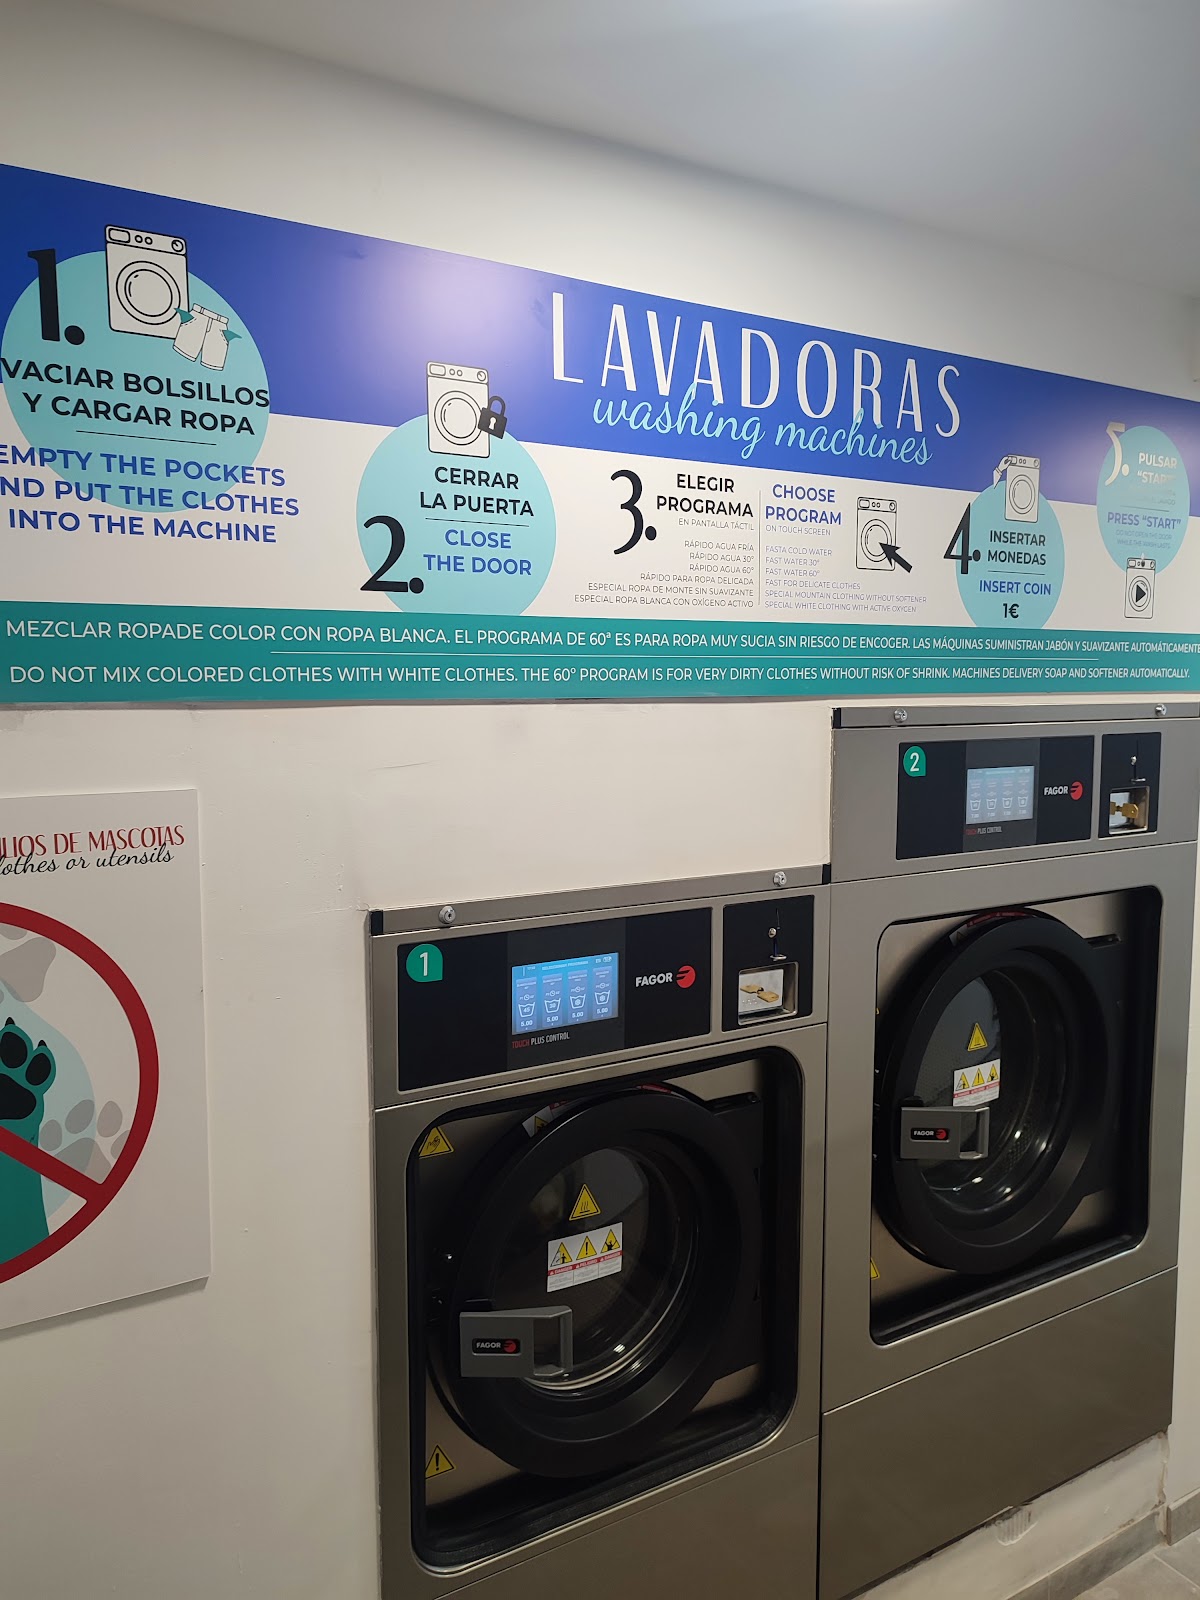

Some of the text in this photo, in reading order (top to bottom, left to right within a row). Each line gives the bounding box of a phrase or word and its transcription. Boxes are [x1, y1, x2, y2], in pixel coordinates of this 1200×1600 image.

[28, 248, 85, 345] 1.
[552, 292, 961, 439] LAVADORAS
[0, 357, 270, 408] VACIAR BOLSILLOS
[22, 392, 255, 435] Y CARGAR ROPA
[592, 381, 933, 466] washing machines
[0, 444, 286, 487] EMPTY THE POCKETS
[1138, 452, 1178, 469] PULSAR
[434, 466, 519, 490] CERRAR
[677, 473, 735, 493] ELEGIR
[55, 480, 300, 517] PUT THE CLOTHES
[772, 484, 836, 503] CHOOSE
[420, 491, 535, 517] LA PUERTA
[610, 469, 657, 555] 3.
[656, 495, 754, 518] PROGRAMA
[765, 505, 842, 525] PROGRAM
[1107, 512, 1140, 526] PRESS
[9, 508, 277, 543] INTO THE MACHINE
[678, 518, 755, 531] EN PANTALLA TÁCTIL
[766, 524, 831, 536] ON TOUCH SCREEN
[445, 529, 512, 549] CLOSE
[684, 540, 755, 552] RÁPIDO AGUA FRÍA
[943, 502, 981, 575] 4.
[989, 530, 1046, 547] INSERTAR
[360, 515, 425, 595] 2.
[689, 552, 741, 563] RÁPIDO AGUA
[765, 546, 833, 557] FASTA COLD WATER
[987, 549, 1046, 566] MONEDAS
[423, 554, 532, 577] THE DOOR
[689, 564, 741, 574] RÁPIDO AGUA
[765, 557, 808, 566] FAST WATER
[640, 572, 754, 586] RÁPIDO PARA ROPA DELICADA
[765, 567, 808, 577] FAST WATER
[588, 583, 754, 597] ESPECIAL ROPA DE MONTE SIN SUAVIZANTE
[765, 578, 861, 590] FAST FOR DELICATE CLOTHES
[979, 580, 1052, 596] INSERT COIN
[574, 594, 754, 608] ESPECIAL ROPA BLANCA CON OXÍGENO ACTIVO
[764, 589, 927, 603] SPECIAL MOUNTAIN CLOTHING WITHOUT SOFTENER
[764, 601, 916, 613] SPECIAL WHITE CLOTHING WITH ACTIVE OXYGEN
[1002, 603, 1019, 619] 1€
[6, 620, 1129, 652] MEZCLAR COLOR CON ROPA BLANCA. EL PROGRAMA DE ES PARA ROPA MUY SUCIA SIN RIESGO DE ENCOGER. LAS MÁQUINAS SUMINISTRAN JABÓN Y SUAVIZANTE
[10, 666, 1190, 683] DO NOT MIX COLORED CLOTHES WITH WHITE CLOTHES. THE PROGRAM IS FOR VERY DIRTY CLOTHES WITHOUT RISK OF SHRINK. MACHINES DELIVERY SOAP AND SOFTENER AUTOMATICALLY.
[909, 752, 920, 772] 2
[1044, 785, 1068, 796] FAGOR
[54, 825, 185, 855] DE MASCOTAS
[66, 842, 175, 871] or utensils
[419, 952, 429, 976] 1
[635, 972, 673, 988] FAGOR
[512, 1032, 570, 1049] TOUCH PLUS CONTROL
